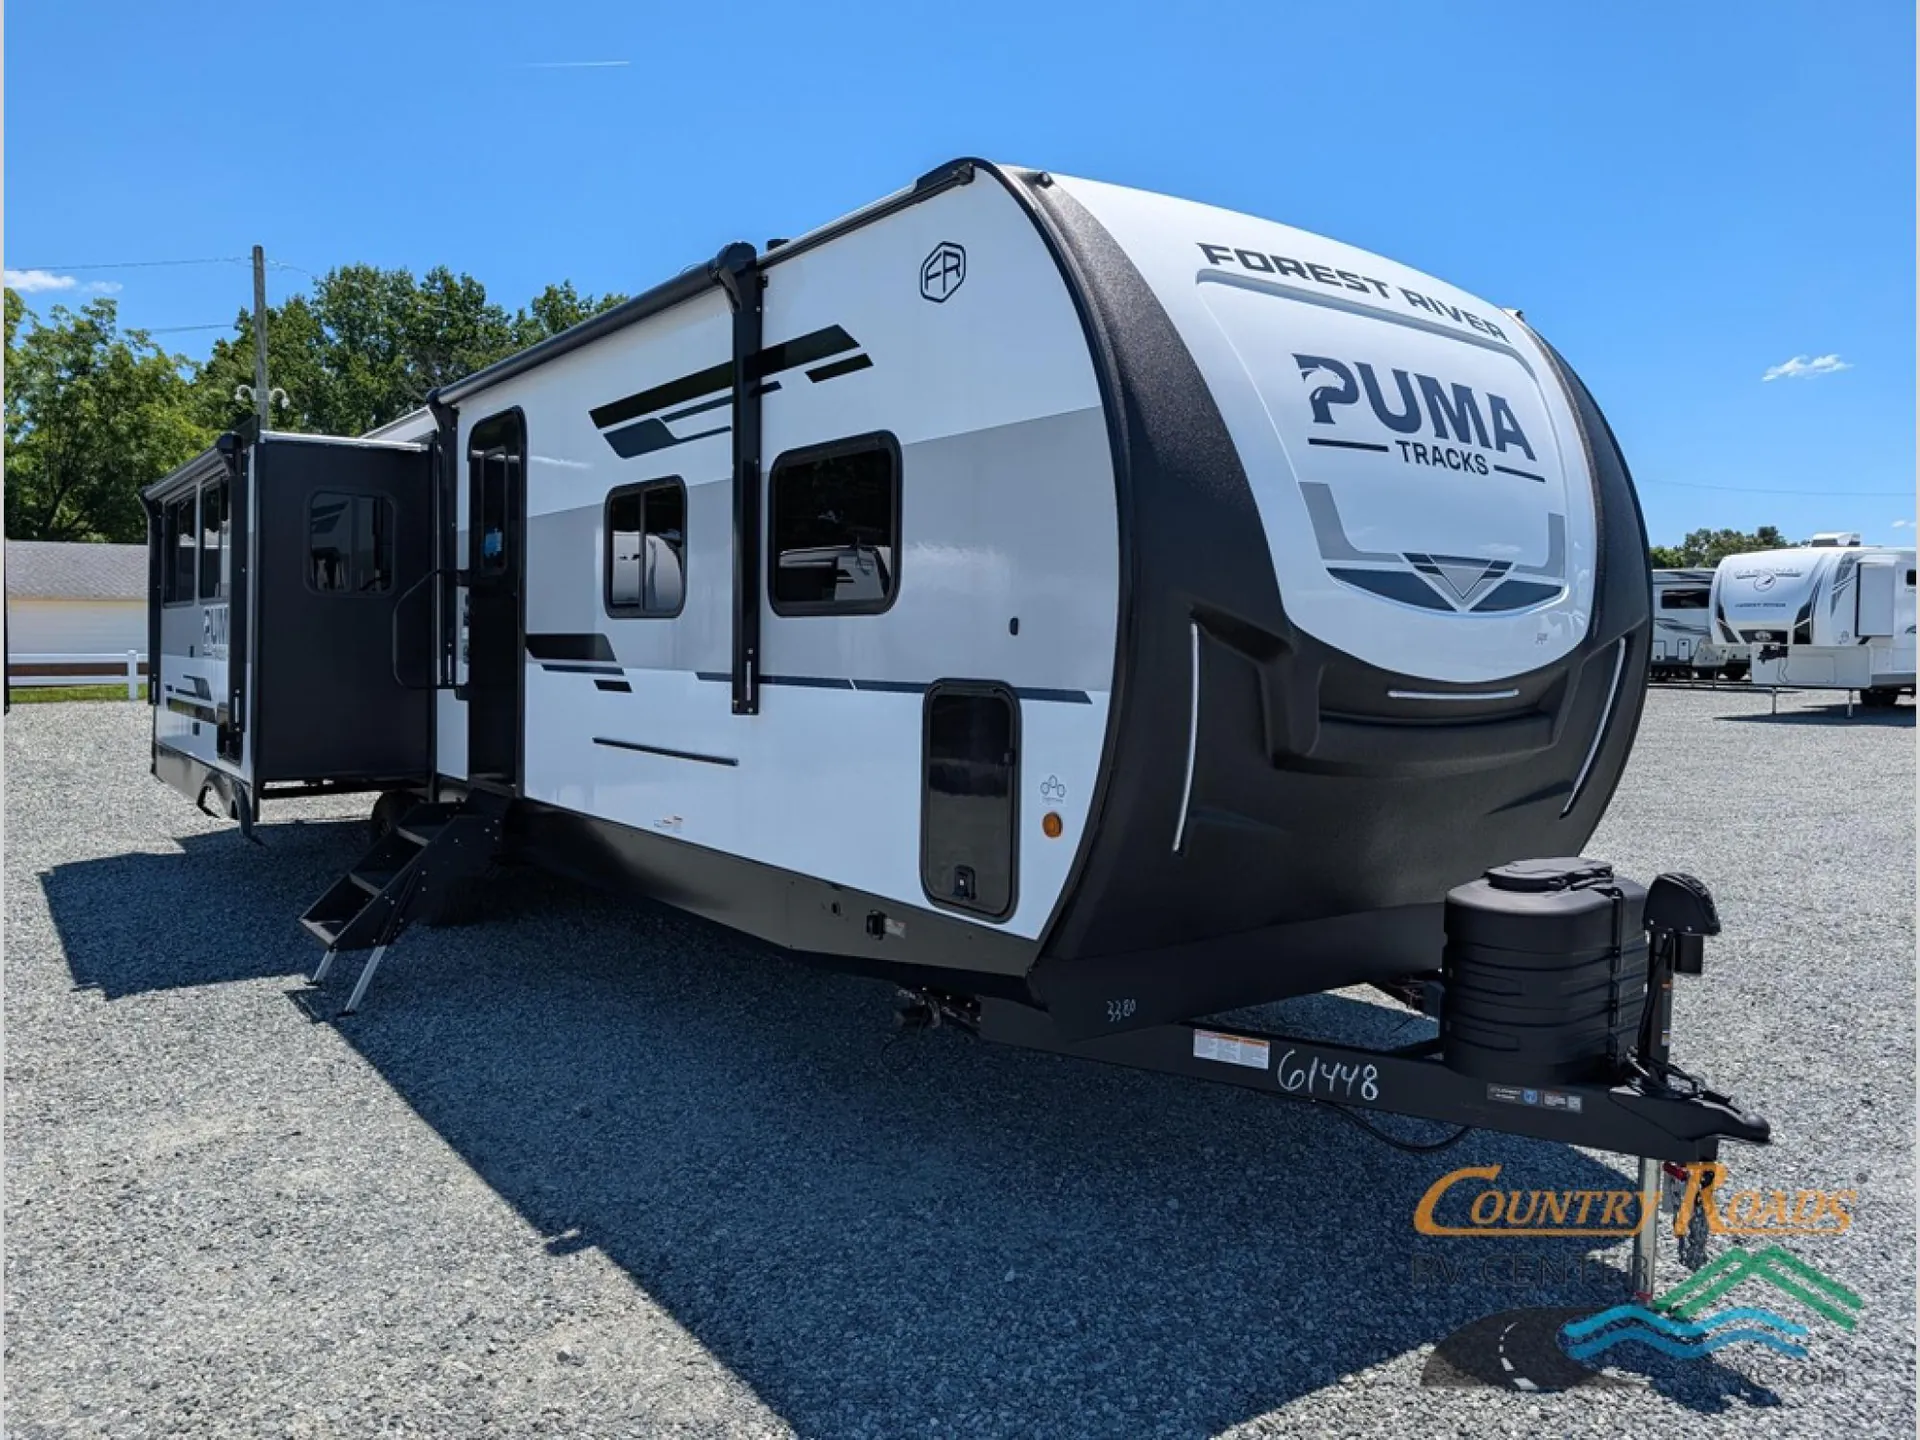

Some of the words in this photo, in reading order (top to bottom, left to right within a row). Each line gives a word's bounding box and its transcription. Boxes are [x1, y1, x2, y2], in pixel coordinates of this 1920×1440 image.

[1196, 242, 1390, 299] FOREST
[1397, 287, 1511, 344] RIVER
[1292, 353, 1537, 462] PUMA
[1395, 440, 1489, 476] TRACKS
[1107, 999, 1136, 1023] 3380
[1277, 1049, 1379, 1100] 61448
